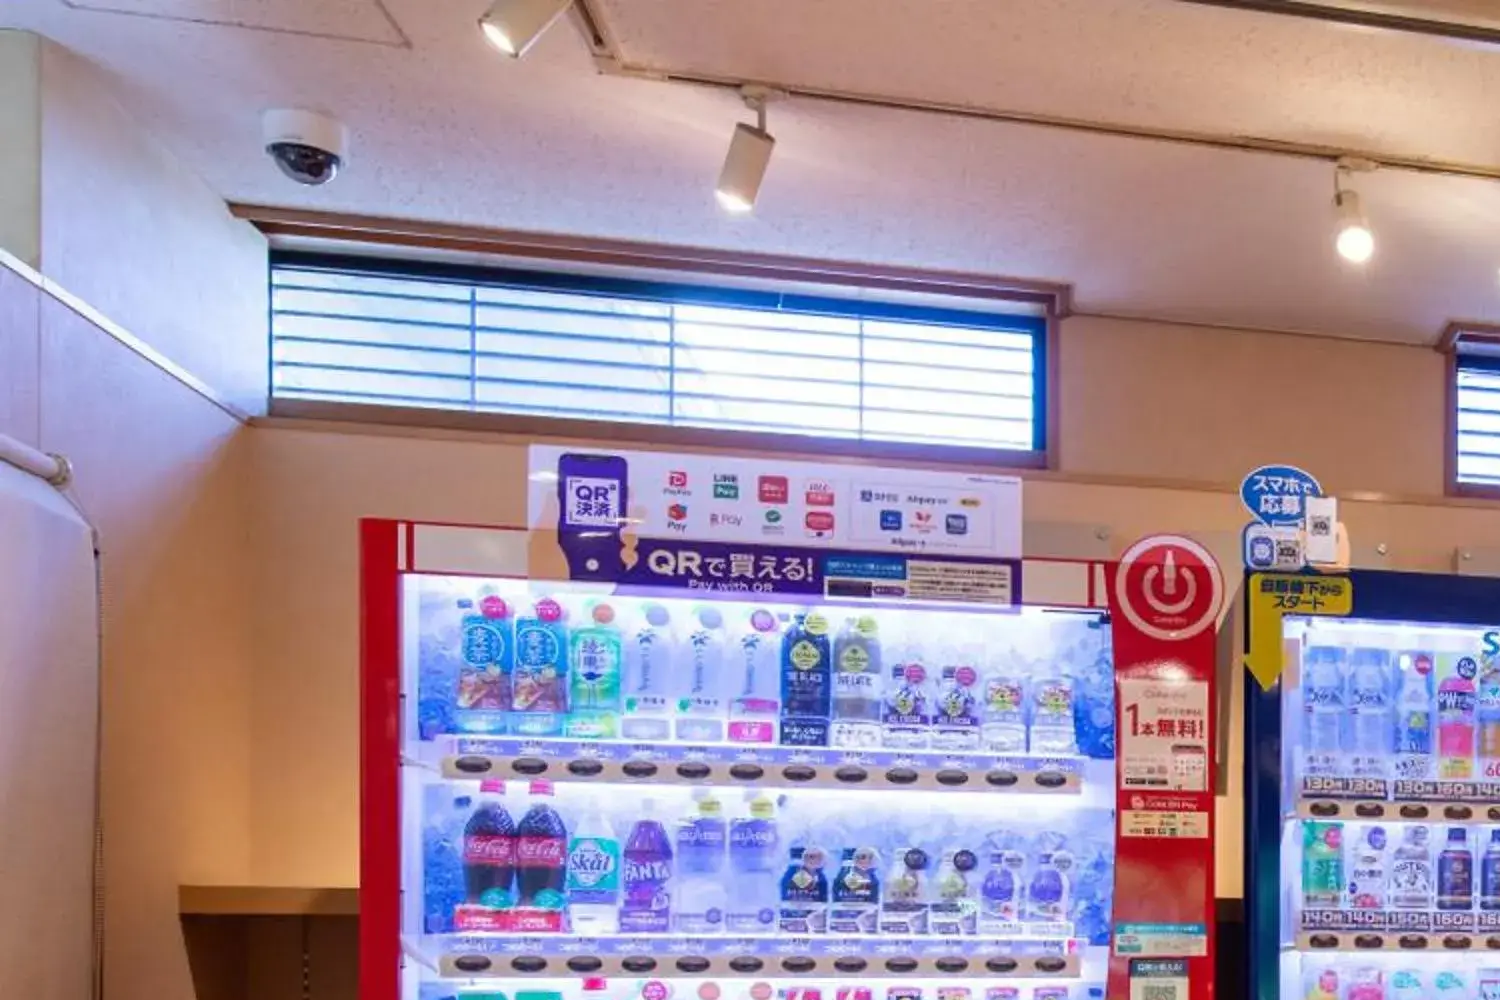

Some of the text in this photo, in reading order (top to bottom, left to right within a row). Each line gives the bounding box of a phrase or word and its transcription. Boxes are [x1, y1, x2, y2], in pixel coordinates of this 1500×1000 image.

[1253, 476, 1313, 492] スマホで
[575, 485, 610, 501] QR
[576, 501, 612, 517] 決済
[1260, 495, 1301, 515] 応募
[721, 514, 743, 528] Pay
[648, 549, 815, 582] QRで買える!
[689, 579, 715, 591] Pay
[717, 580, 749, 592] with
[1273, 596, 1326, 611] スタート
[1125, 702, 1205, 739] 1本無料!
[624, 862, 671, 880] FANTA
